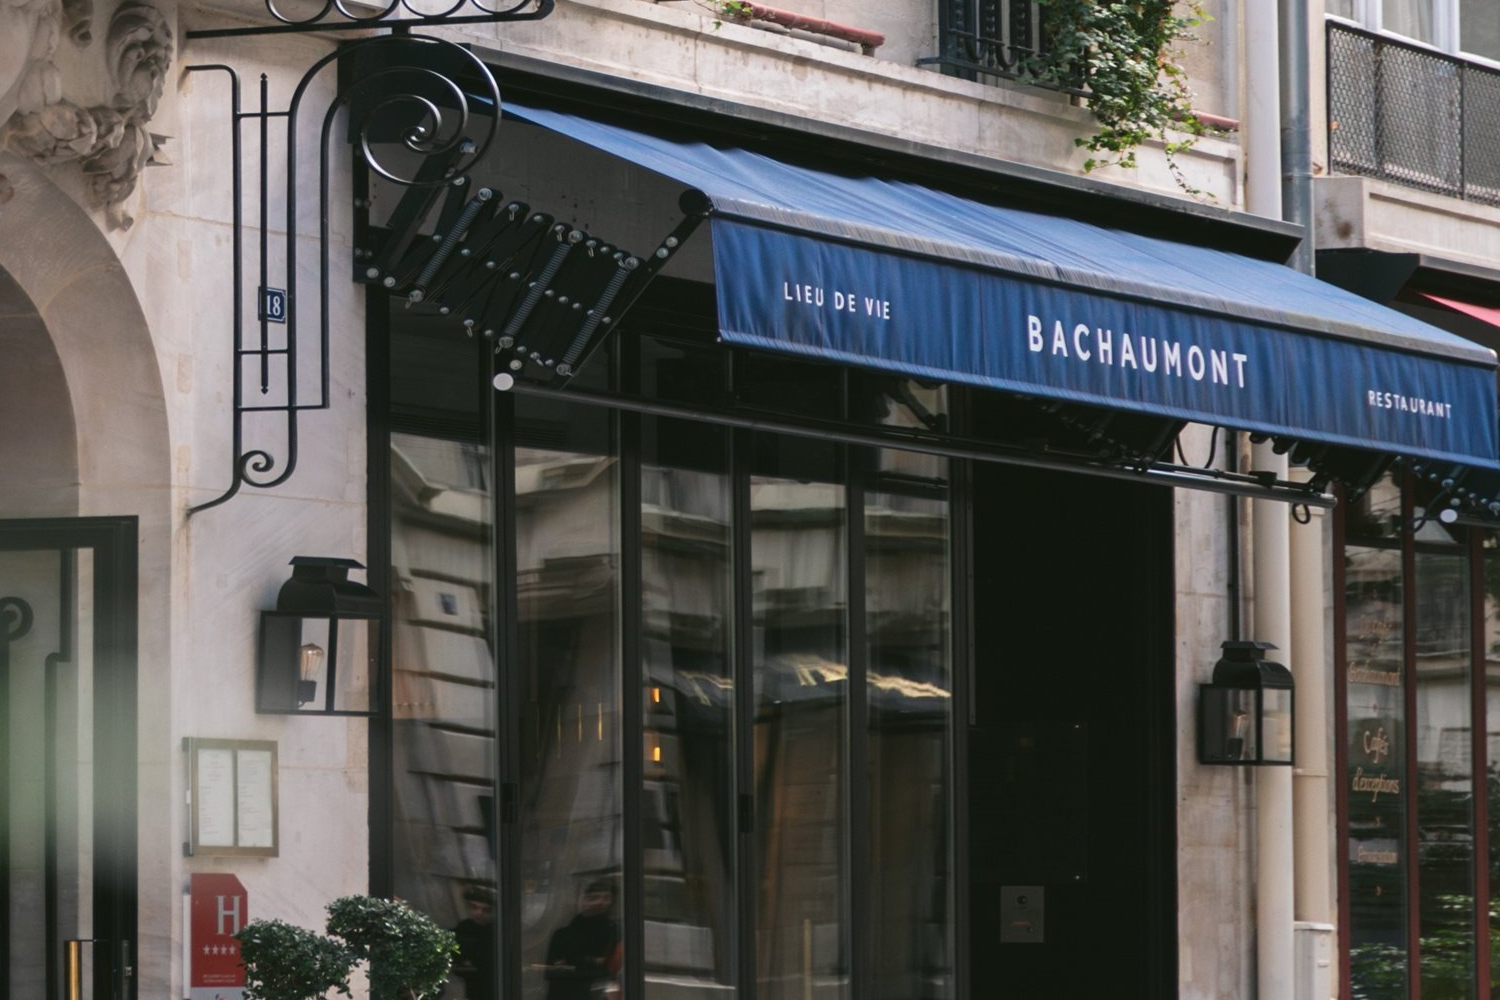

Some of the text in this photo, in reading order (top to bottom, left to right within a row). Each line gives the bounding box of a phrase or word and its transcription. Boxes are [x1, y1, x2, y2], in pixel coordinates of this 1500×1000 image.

[267, 295, 281, 316] 18
[784, 281, 891, 320] LIEU DE VIE
[1027, 314, 1248, 389] BACHAUMONT
[1367, 390, 1452, 419] RESTAURANT
[215, 895, 242, 937] H
